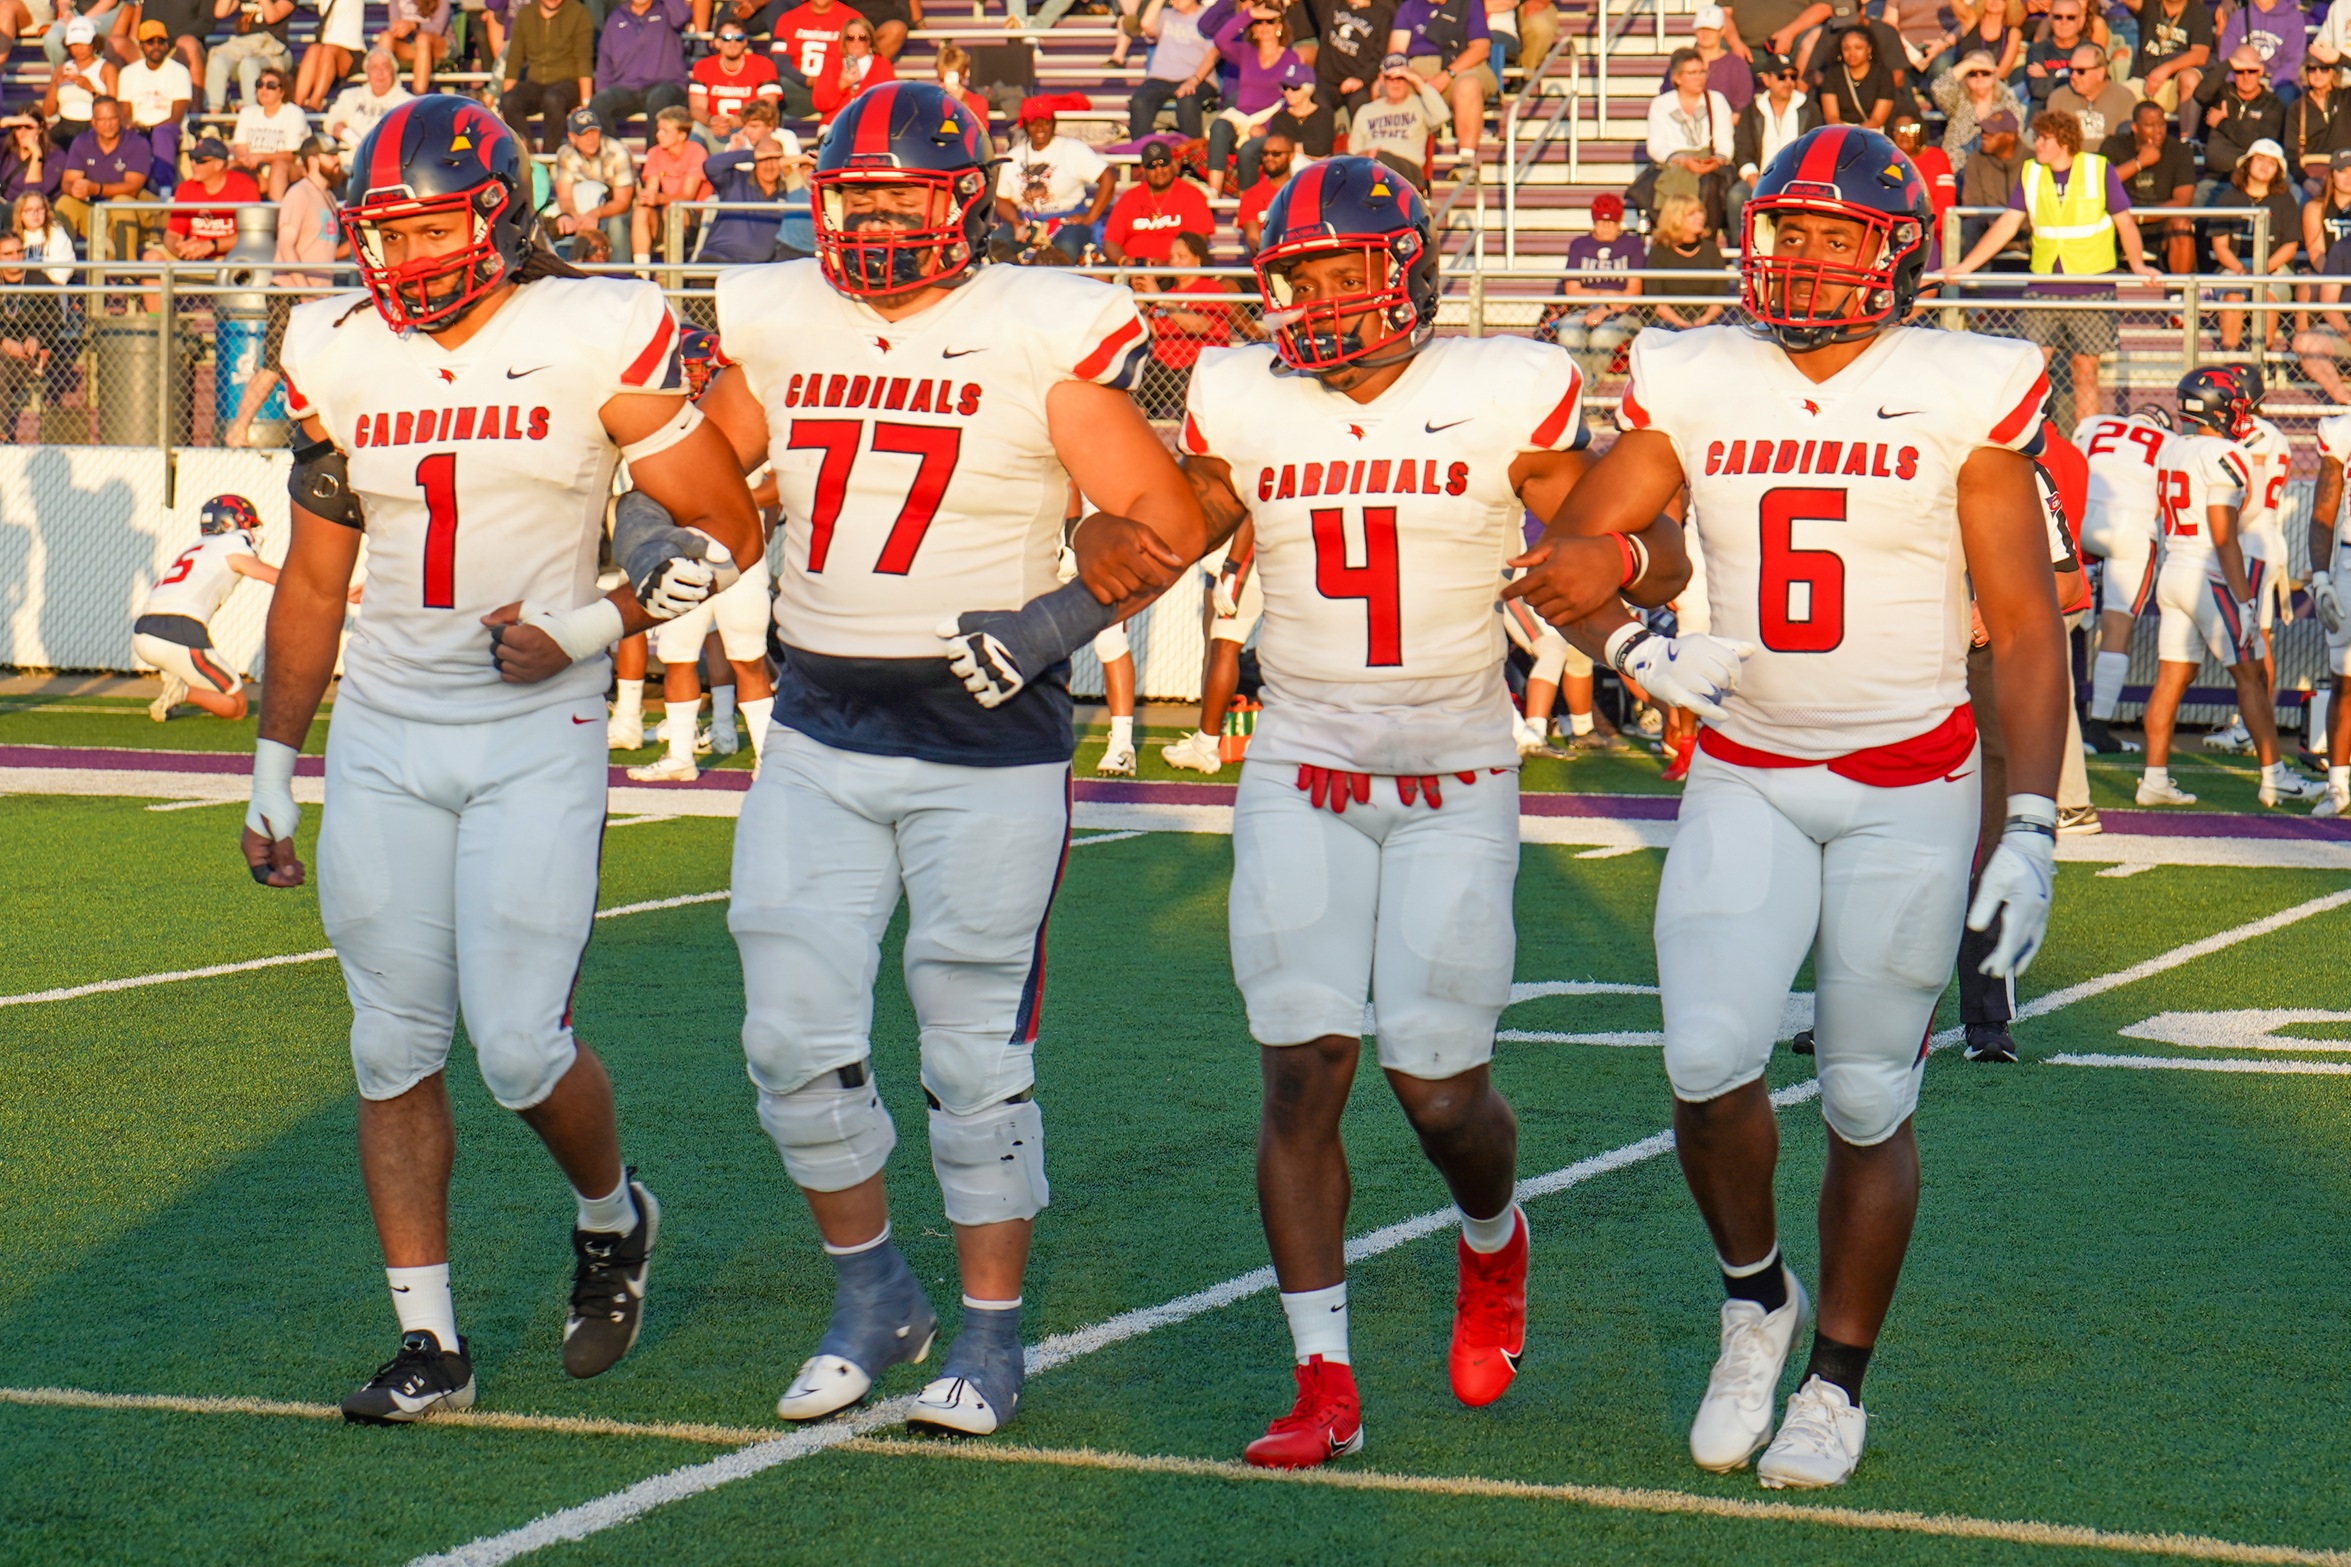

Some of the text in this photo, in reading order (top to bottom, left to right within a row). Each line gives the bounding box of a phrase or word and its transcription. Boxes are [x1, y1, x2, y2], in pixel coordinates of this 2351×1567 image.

[801, 41, 827, 77] 6
[1367, 111, 1417, 129] WINONA
[1789, 184, 1829, 195] SVSU
[190, 216, 234, 231] SVSU
[1132, 214, 1182, 231] SVSU
[1285, 225, 1323, 240] SVSU
[785, 373, 983, 416] CARDINALS
[354, 405, 550, 448] CARDINALS
[2087, 421, 2165, 468] 29
[1258, 458, 1469, 502] CARDINALS
[1705, 439, 1919, 480] CARDINALS
[787, 418, 963, 576] 77
[415, 452, 458, 609] 1
[153, 544, 204, 590] 5
[1309, 505, 1403, 668] 4
[1758, 486, 1848, 654] 6
